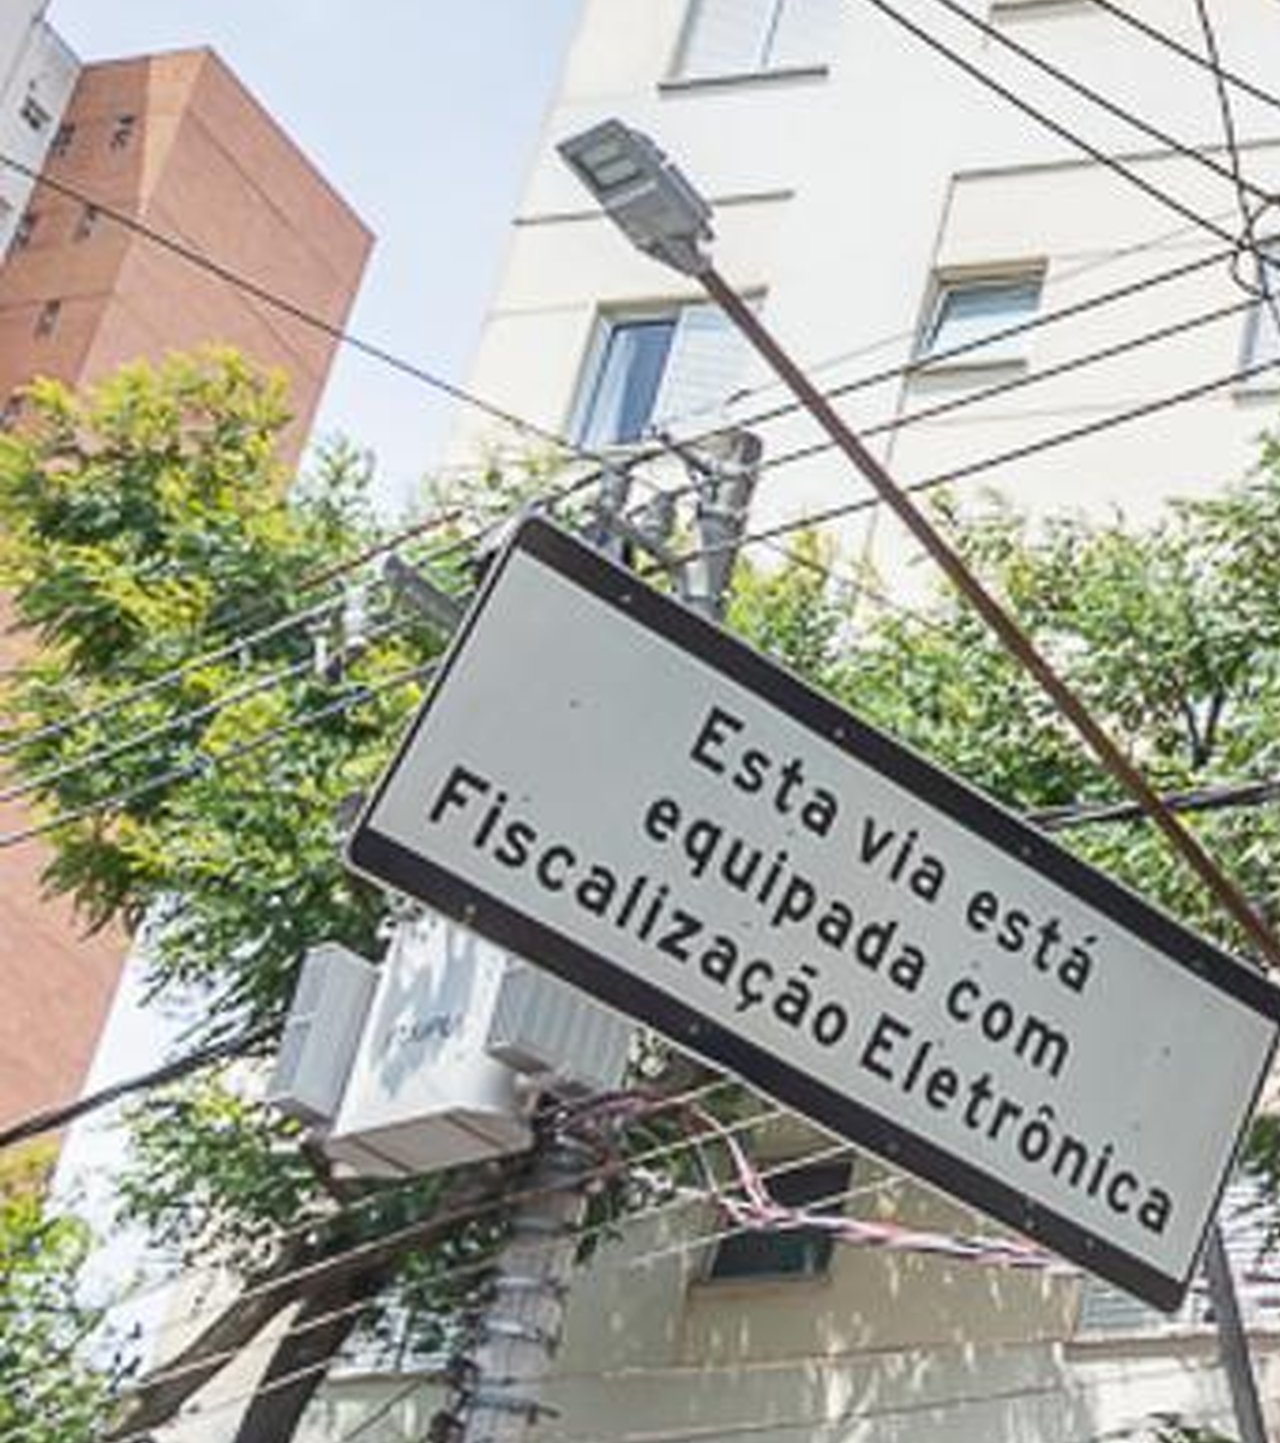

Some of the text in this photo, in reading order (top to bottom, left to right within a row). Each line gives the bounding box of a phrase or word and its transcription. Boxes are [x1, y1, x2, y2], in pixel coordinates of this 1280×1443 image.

[644, 798, 1069, 1078] equipada com
[690, 706, 1098, 994] Esta via está
[429, 765, 1172, 1235] Fiscalização Eletrônica
